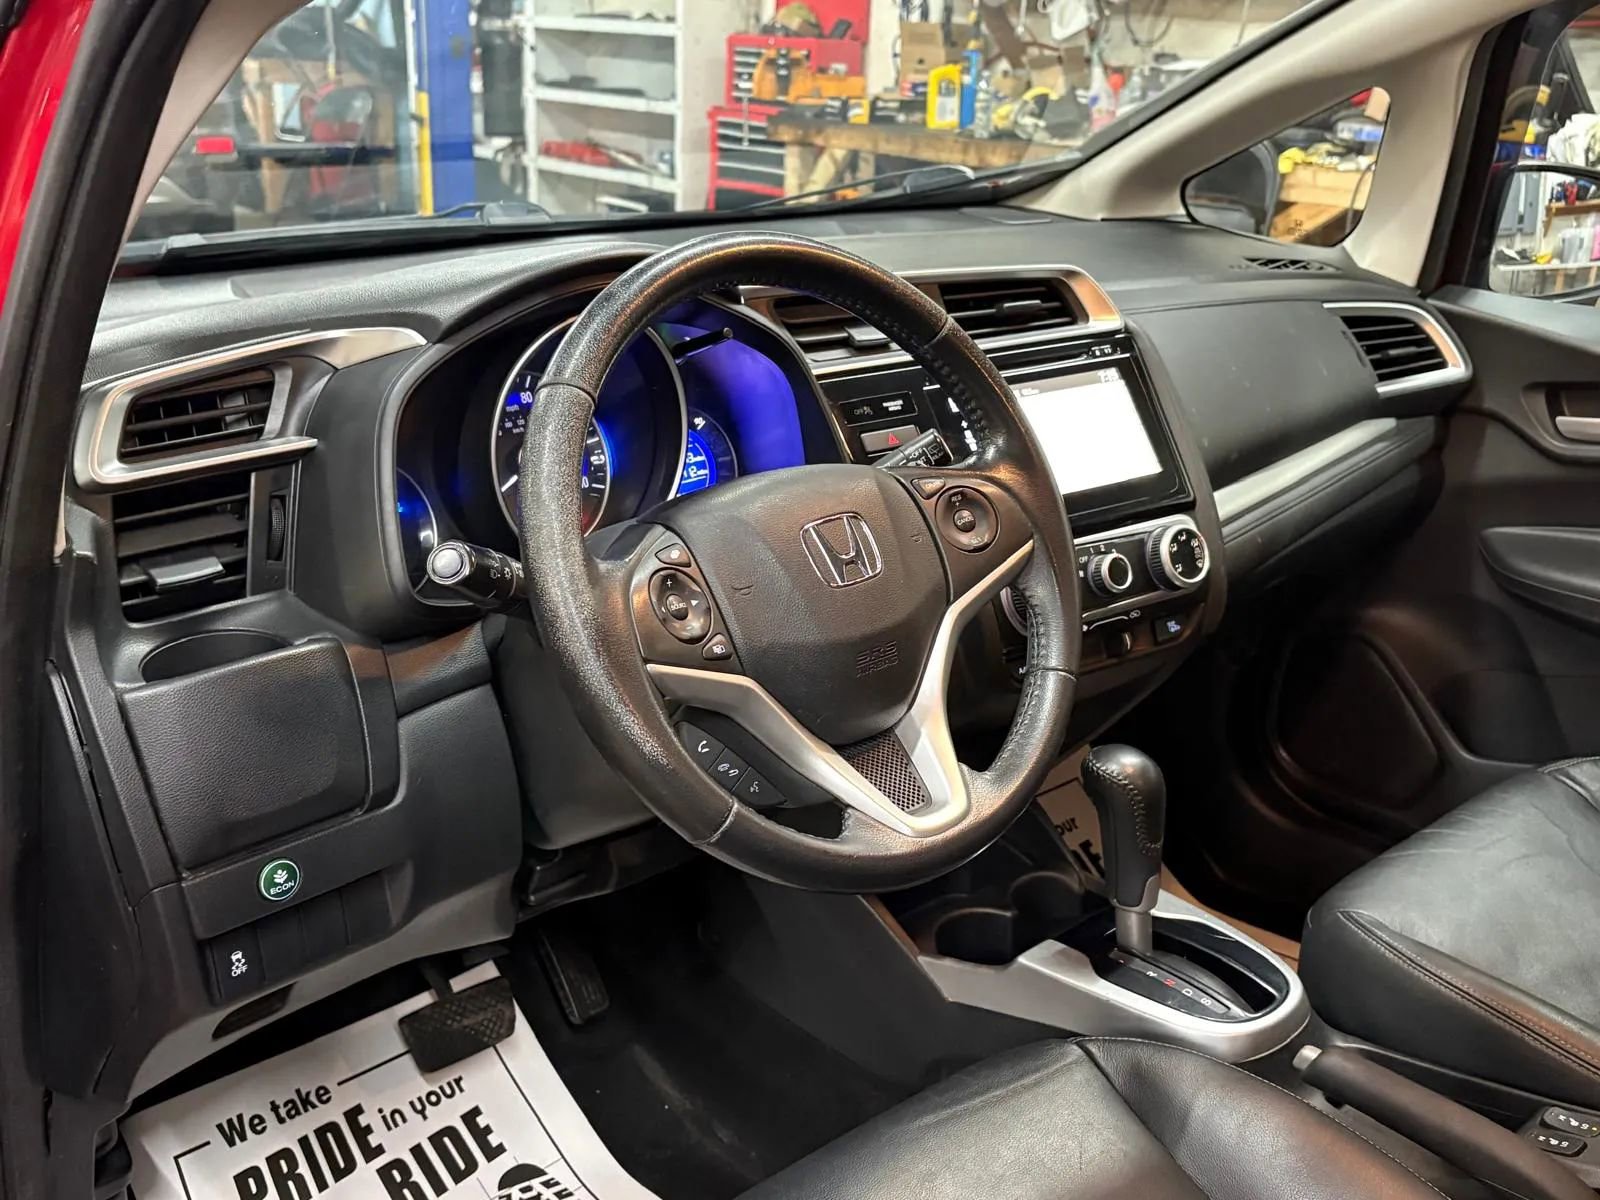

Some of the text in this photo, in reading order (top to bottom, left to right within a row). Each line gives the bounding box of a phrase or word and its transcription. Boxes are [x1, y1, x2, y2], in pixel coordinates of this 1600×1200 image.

[520, 391, 533, 404] 80
[1055, 816, 1079, 836] our
[269, 880, 295, 896] ECON
[231, 964, 248, 977] OFF
[1182, 988, 1193, 997] D
[215, 1085, 332, 1148] We take
[233, 1075, 465, 1200] PRIDE in your
[376, 1104, 507, 1200] RIDE
